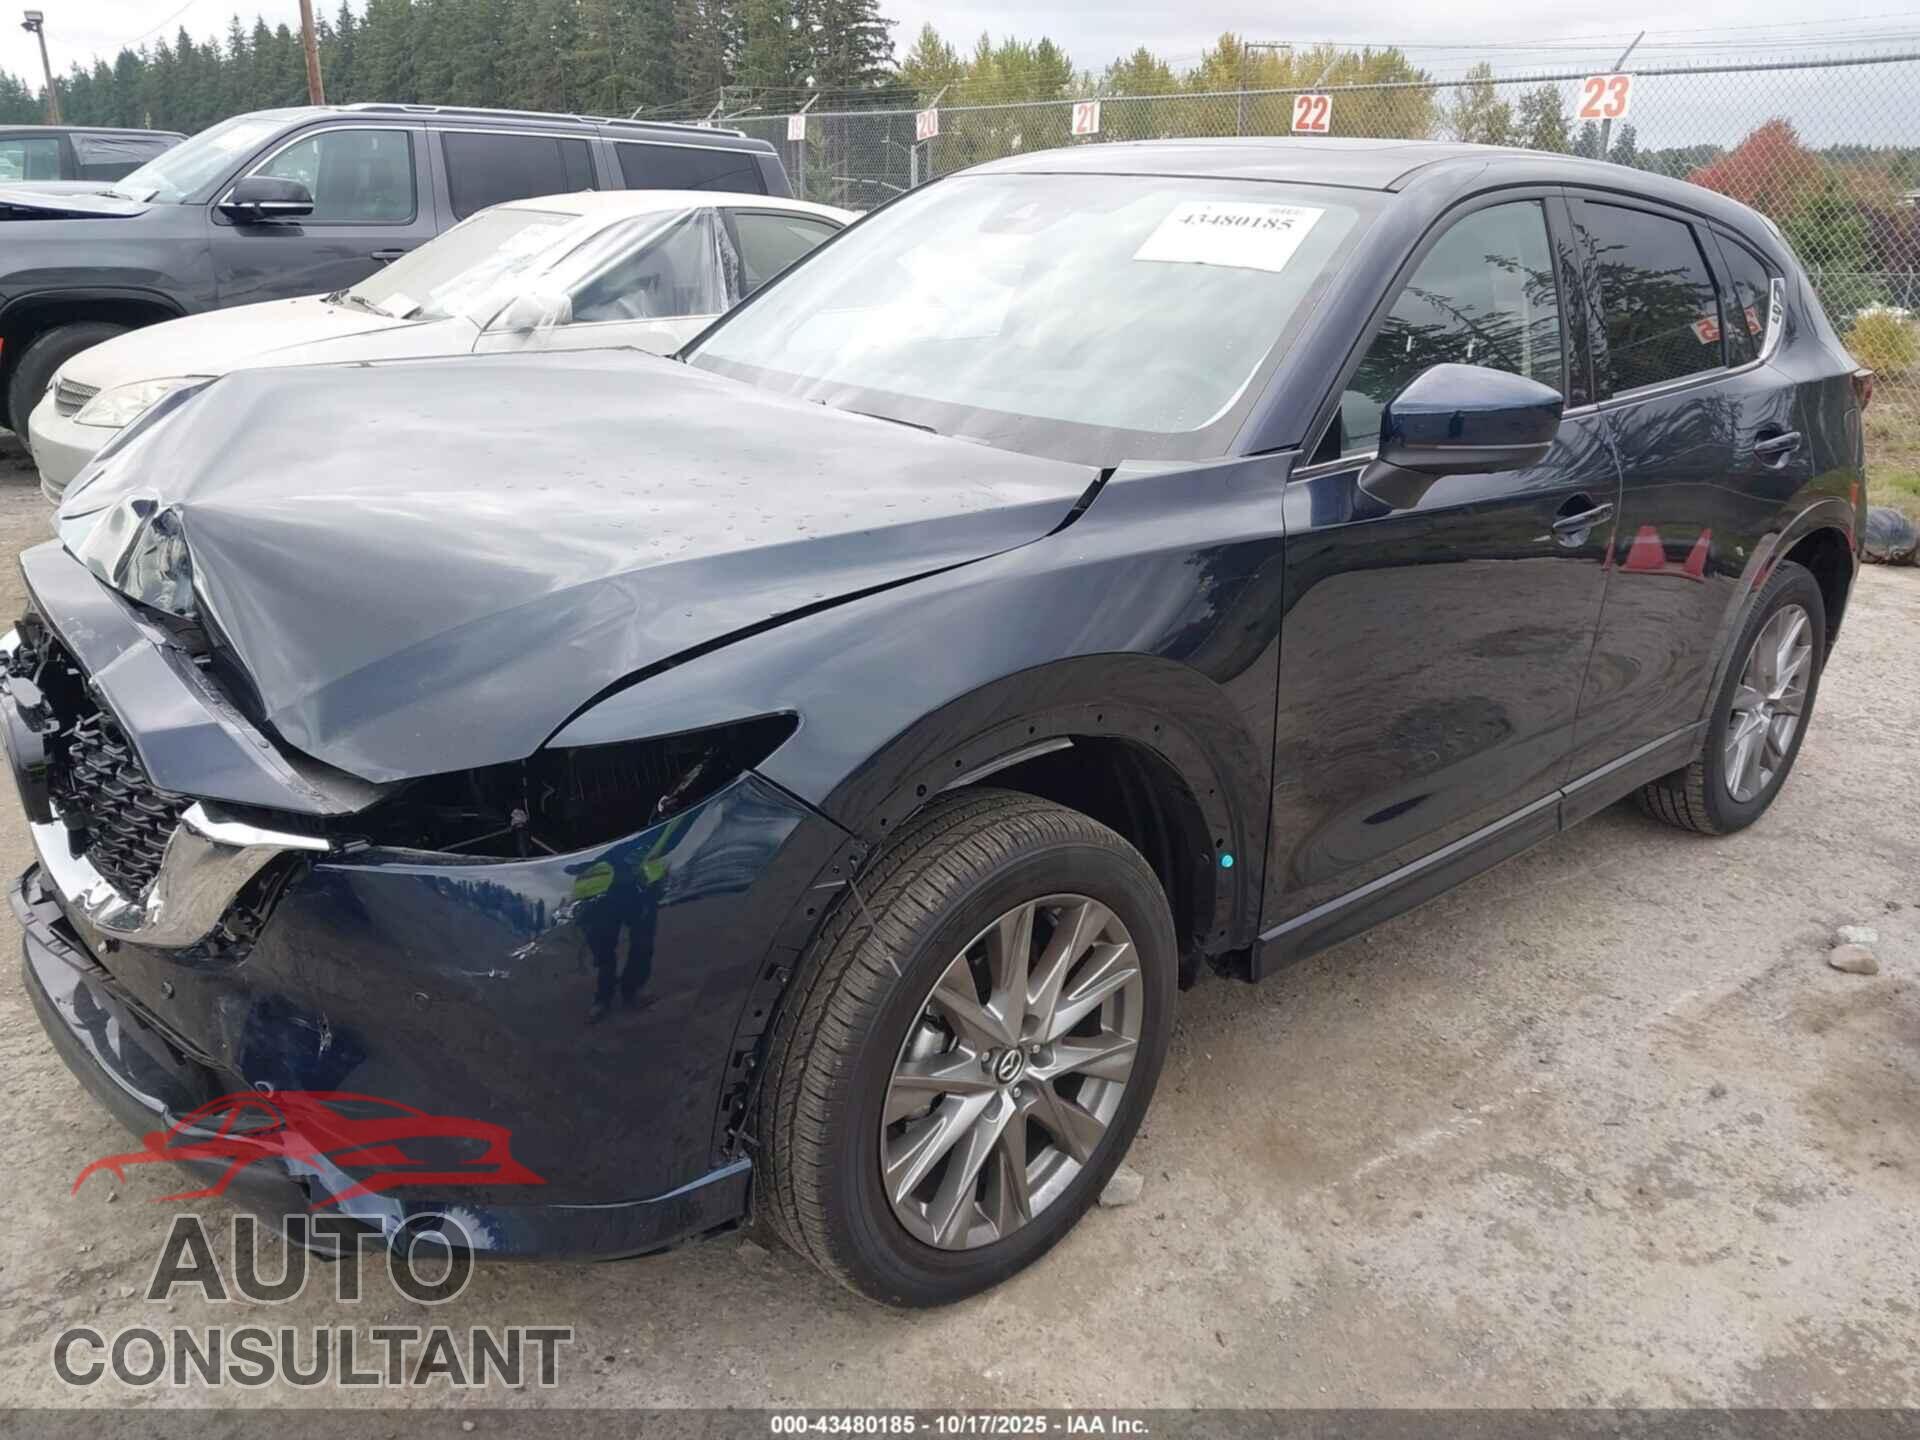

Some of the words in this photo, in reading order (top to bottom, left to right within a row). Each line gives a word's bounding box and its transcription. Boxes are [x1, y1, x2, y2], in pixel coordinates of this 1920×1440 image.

[1579, 75, 1630, 118] 23
[918, 110, 938, 139] 20
[1075, 103, 1096, 133] 21
[1294, 95, 1330, 131] 22
[1178, 213, 1296, 231] 43480185
